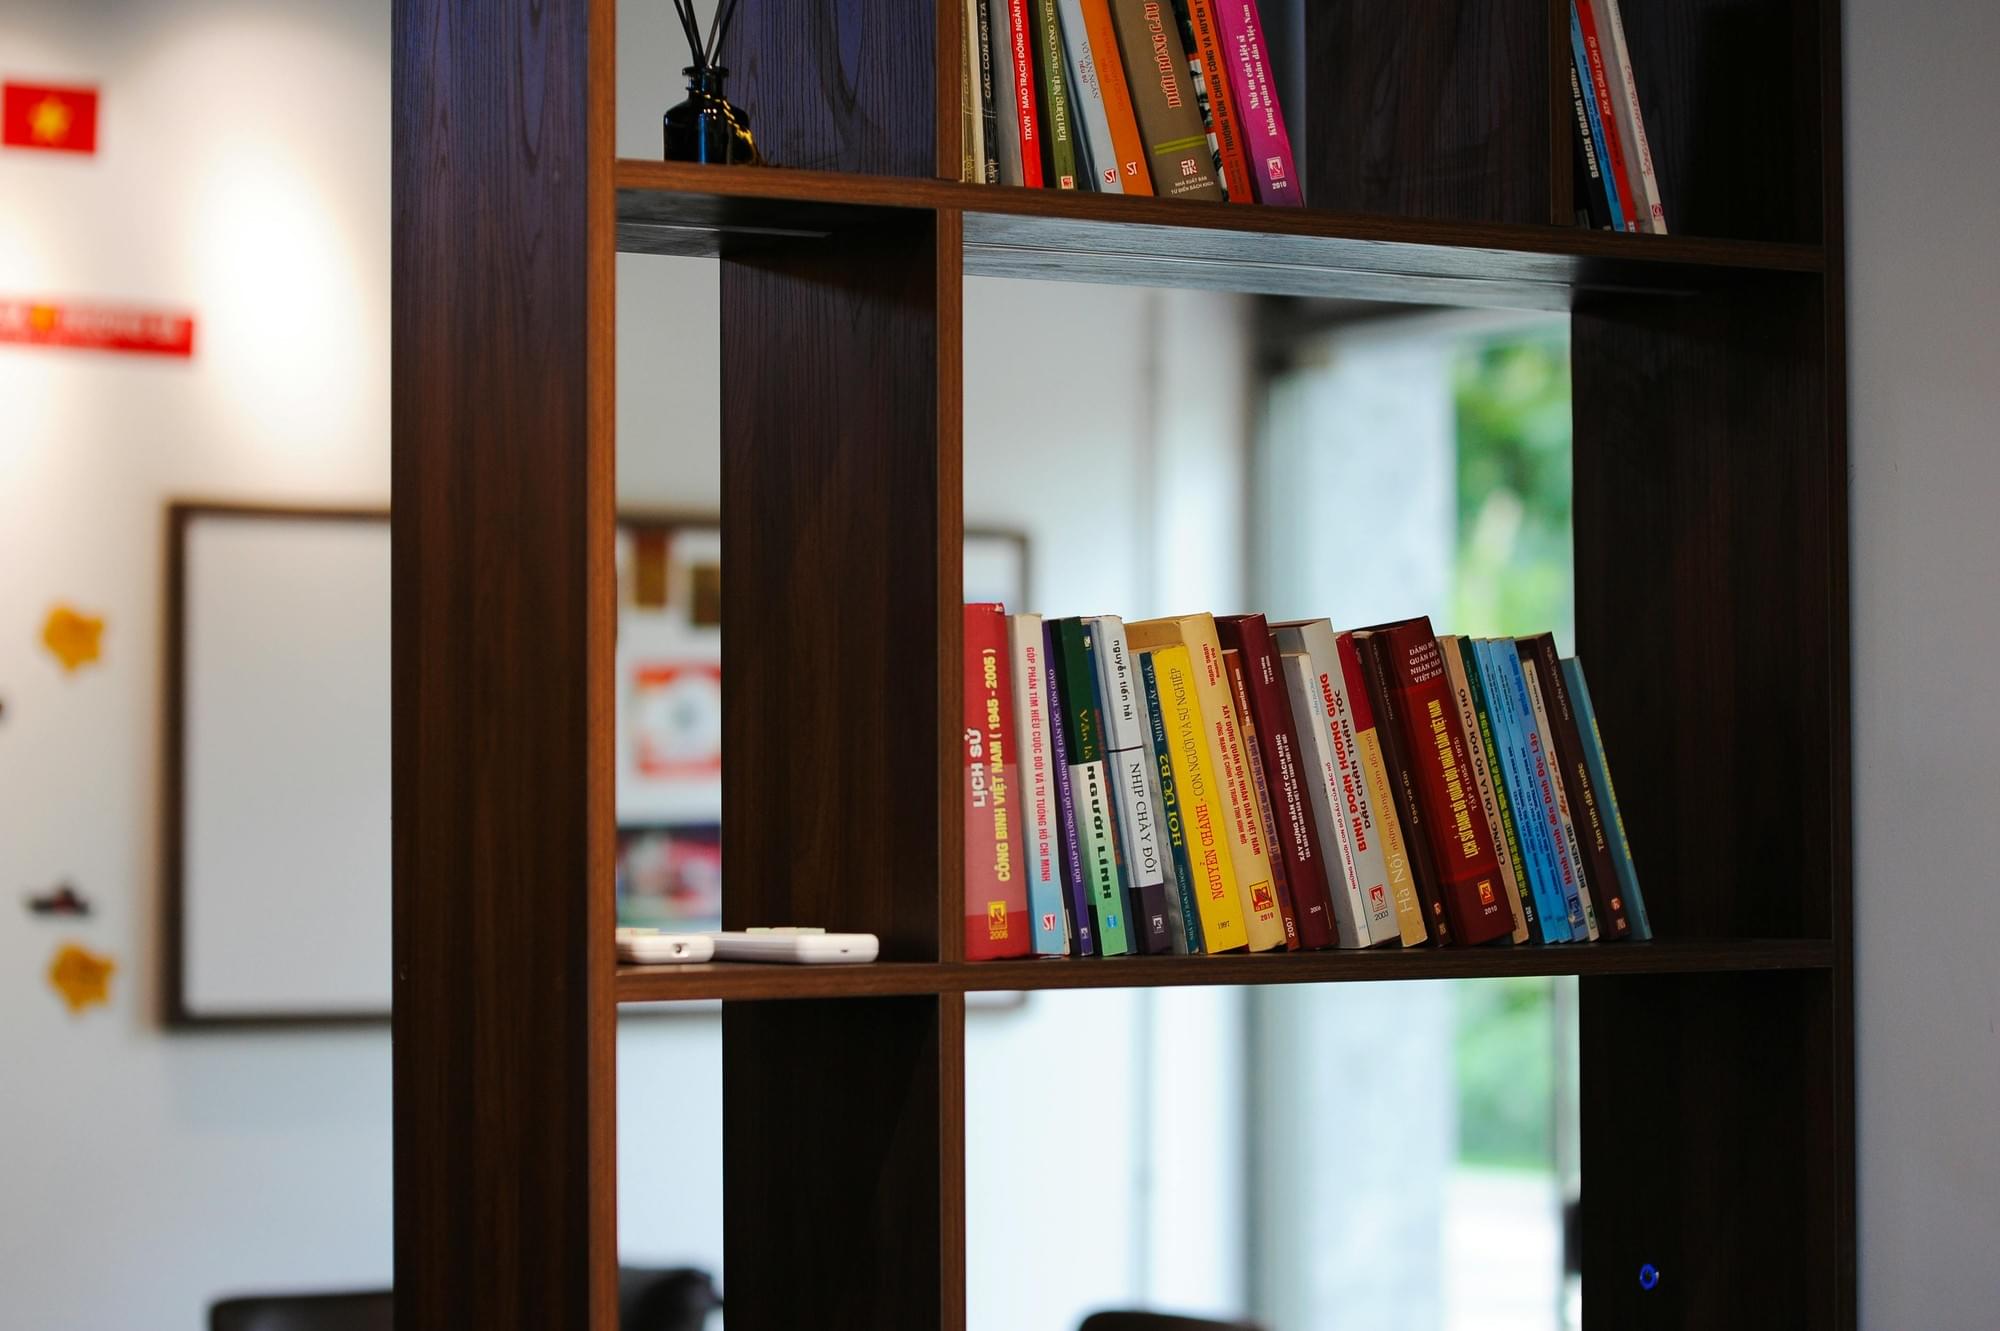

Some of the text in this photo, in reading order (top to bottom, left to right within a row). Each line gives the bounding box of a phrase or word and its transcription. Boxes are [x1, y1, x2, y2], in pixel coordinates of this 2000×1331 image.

[1048, 25, 1057, 51] CÔNG
[1247, 26, 1256, 42] Việt
[1016, 33, 1025, 59] ĐÔNG
[1240, 45, 1250, 61] Liệt
[1019, 60, 1028, 86] TRẠCH
[1244, 63, 1253, 78] các
[1256, 62, 1265, 83] nhân
[1052, 76, 1061, 96] Ninh
[1261, 85, 1272, 106] quân
[1266, 108, 1277, 136] Không
[1576, 100, 1589, 136] OBAMA
[1584, 138, 1599, 178] BARACK
[1027, 647, 1036, 664] GÓP
[1028, 667, 1037, 690] PHẦN
[1113, 640, 1133, 721] nguyễn tiến hải
[1030, 693, 1039, 707] TÌM
[1458, 689, 1468, 708] HỒ
[1031, 710, 1041, 729] HIỂU
[1464, 711, 1473, 728] CỤ
[1032, 731, 1042, 754] CUỘC
[1470, 731, 1480, 755] ĐỘI
[1530, 733, 1539, 754] Lập
[965, 729, 988, 807] LỊCH SỬ
[984, 657, 1010, 881] CÔNG BINH VIỆT NAM 1945 2005
[1034, 757, 1044, 770] ĐỜI
[1280, 759, 1289, 780] CÁCH
[1320, 674, 1367, 852] BINH ĐOÀN HƯƠNG GIANG
[1335, 690, 1371, 829] DẤU CHÂN THẦN TỐC
[1475, 758, 1485, 776] BỘ
[1536, 756, 1546, 778] Độc
[1035, 773, 1044, 784] VÀ
[1170, 668, 1224, 900] NGUYỄN CHÁNH CON NGƯỜI VÀ SỰ NGHIỆP
[1222, 705, 1261, 856] XÂY DỰNG QUÂN ĐỘI NHÂN DÂN VIỆT NAM
[1428, 700, 1480, 858] LỊCH SỬ ĐẢNG BỘ QUÂN ĐỘI NHÂN DÂN VIỆT NAM
[1160, 754, 1182, 846] HỒI ỨC B2
[1284, 782, 1294, 803] CHẤT
[1541, 780, 1552, 804] Dinh
[1381, 793, 1391, 820] tháng
[1485, 798, 1494, 819] TÔI
[1130, 764, 1144, 798] NHỊP
[1143, 847, 1157, 874] ĐÔI
[1039, 829, 1048, 840] HỒ
[1088, 766, 1112, 899] NGƯỜI LÍNH
[1293, 822, 1302, 844] DỰNG
[1388, 821, 1399, 851] những
[1554, 829, 1565, 855] trình
[1040, 843, 1049, 857] CHÍ
[1073, 868, 1082, 883] HỎI
[1561, 857, 1572, 885] Hành
[1388, 854, 1413, 913] Hà Nội
[1484, 905, 1497, 915] 2010
[1042, 914, 1056, 930] ST
[1285, 917, 1295, 937] 2007
